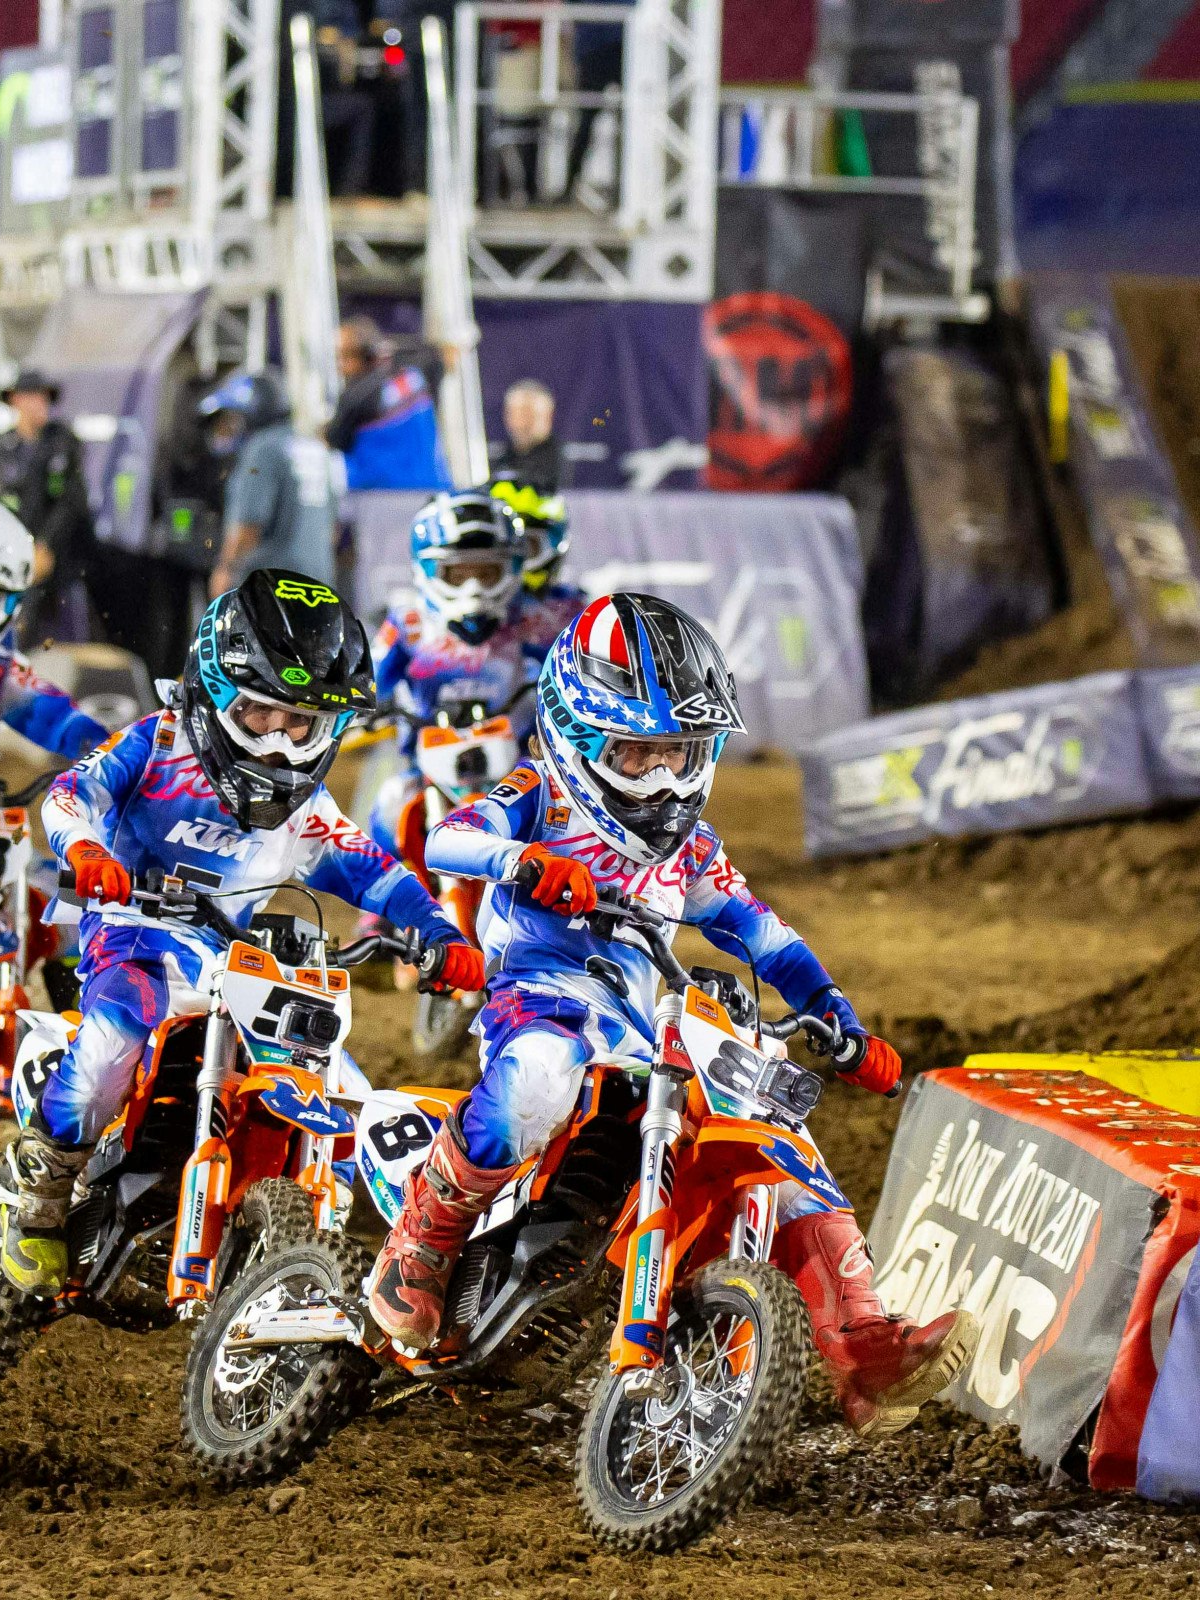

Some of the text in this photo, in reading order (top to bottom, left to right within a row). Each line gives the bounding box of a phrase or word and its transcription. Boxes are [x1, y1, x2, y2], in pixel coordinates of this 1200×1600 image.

[323, 693, 348, 704] FOX
[542, 676, 592, 754] 100%
[922, 711, 1056, 824] Finals
[164, 817, 253, 863] KTM
[707, 1039, 766, 1100] 8
[296, 1110, 339, 1129] KTM
[368, 1113, 434, 1162] 8
[808, 1177, 845, 1203] KTM
[194, 1191, 205, 1240] DUNLOP
[633, 1266, 647, 1308] MOTOREX
[647, 1258, 660, 1308] DUNLOP
